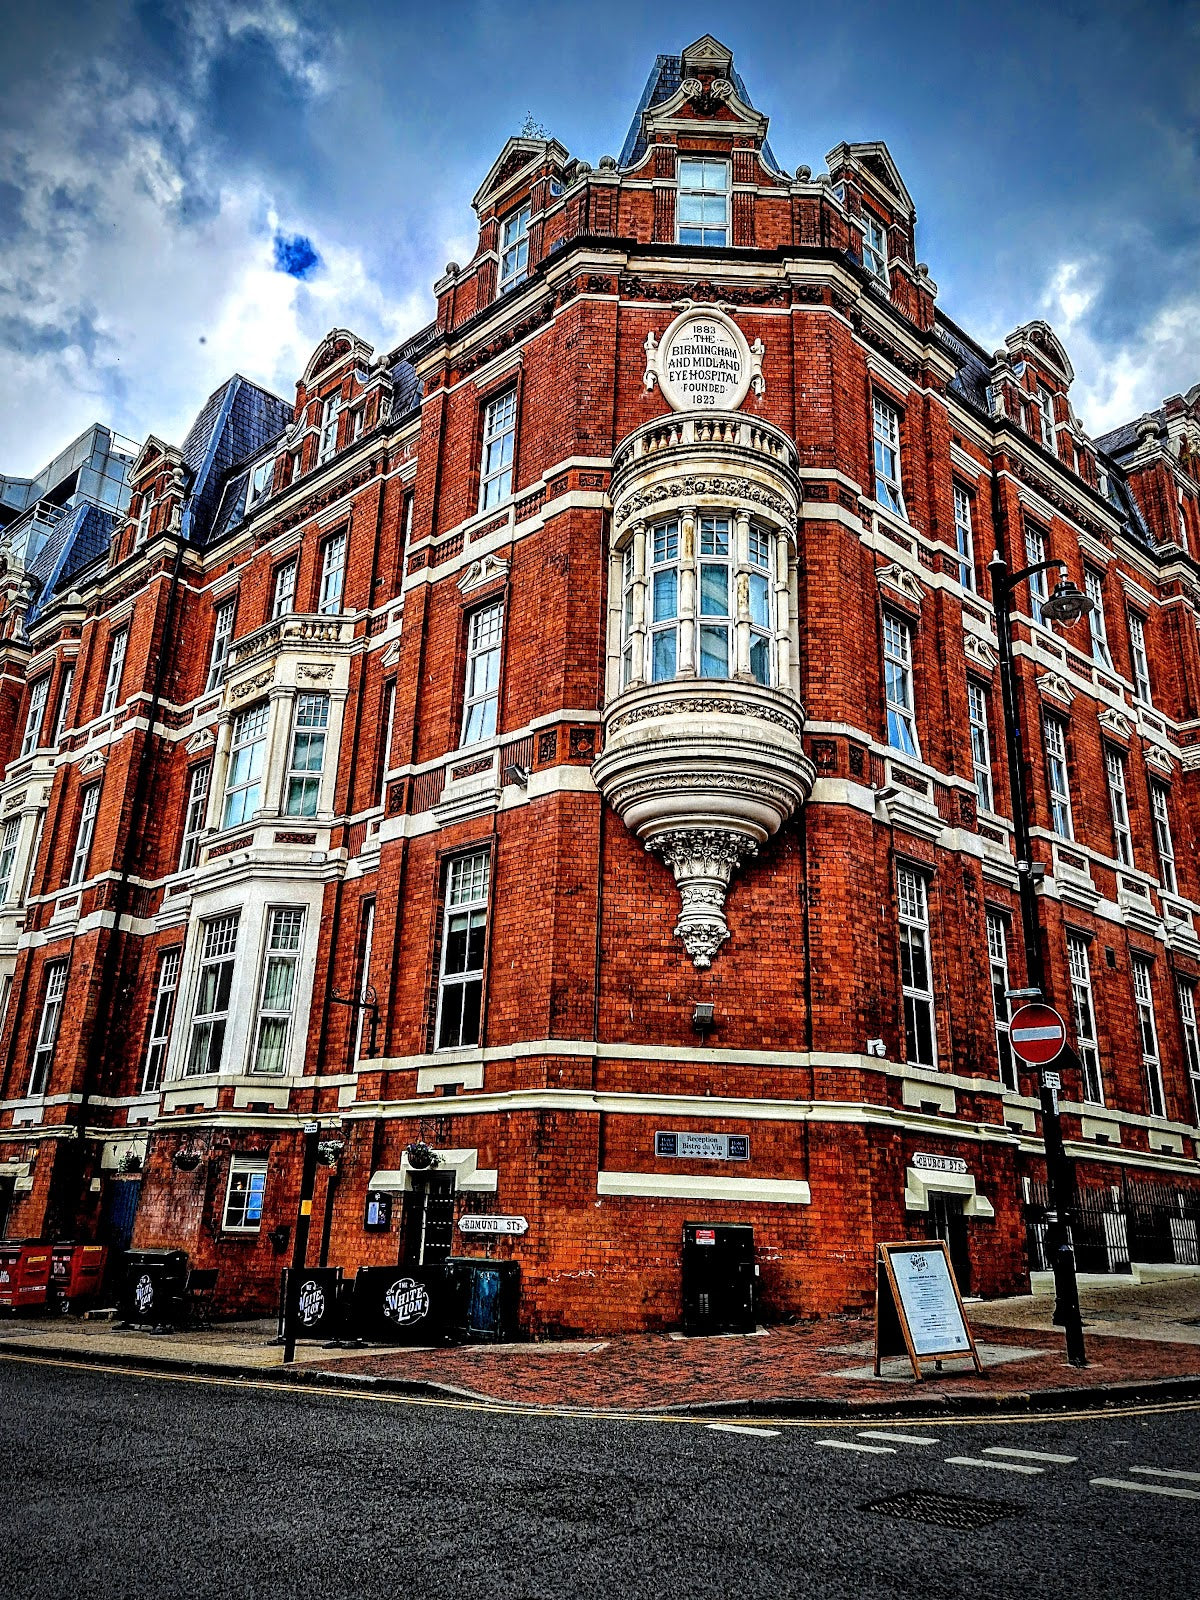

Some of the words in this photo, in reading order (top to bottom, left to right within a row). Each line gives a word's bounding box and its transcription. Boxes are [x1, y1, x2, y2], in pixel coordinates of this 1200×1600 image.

[693, 326, 716, 334] 1883
[693, 335, 715, 343] THE
[672, 345, 737, 359] BIRMINGHAM
[668, 357, 691, 369] AND
[693, 357, 740, 371] MIDLAND
[669, 370, 688, 382] EYE
[689, 370, 739, 384] HOSPITAL
[683, 383, 726, 393] FOUNDED
[692, 395, 715, 404] 1823
[682, 1142, 701, 1150] Bistro
[919, 1156, 945, 1169] CHURCH
[465, 1220, 498, 1230] EDMUND
[386, 1287, 423, 1310] WHITE
[398, 1299, 422, 1321] LION
